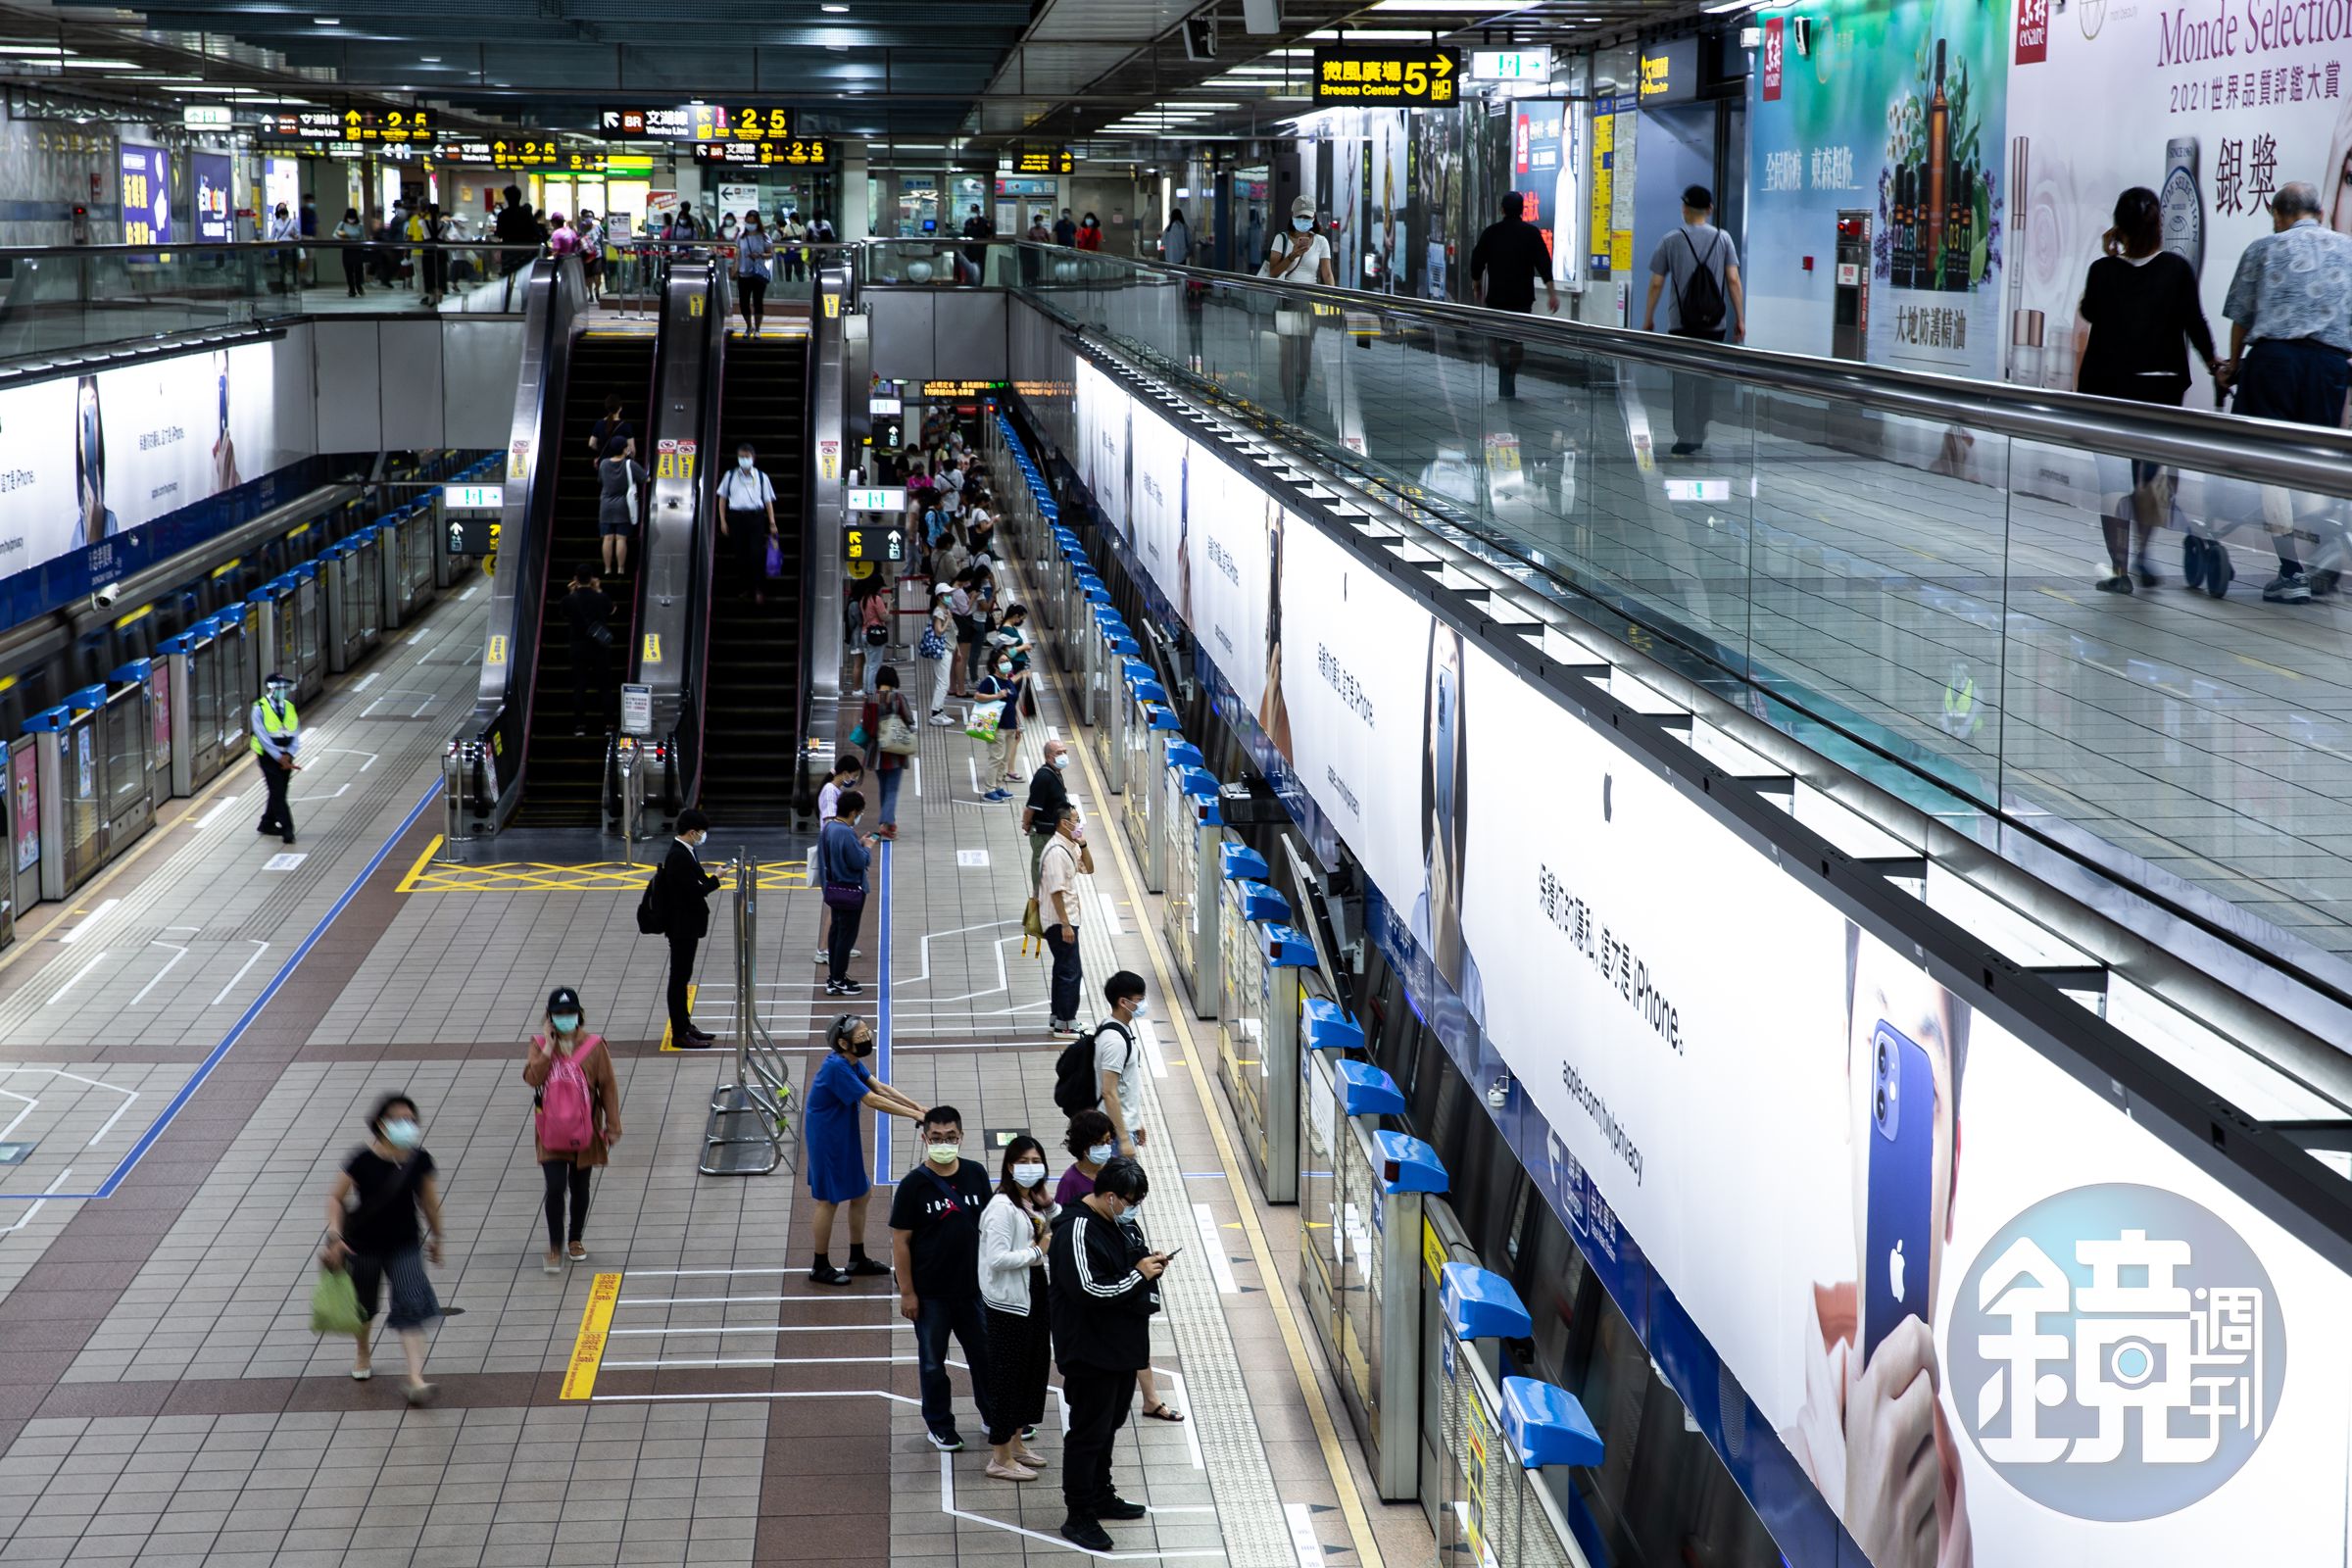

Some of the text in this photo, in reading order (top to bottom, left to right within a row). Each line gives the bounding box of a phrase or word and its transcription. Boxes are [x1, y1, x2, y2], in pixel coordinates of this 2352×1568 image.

[2157, 0, 2237, 67] Monde
[1323, 61, 1401, 81] 微風廣場
[1403, 62, 1427, 95] 5
[1320, 84, 1401, 95] Breeze Center
[625, 116, 642, 127] BR
[741, 108, 758, 129] 2
[770, 110, 786, 129] 5
[792, 141, 804, 156] 2
[811, 141, 823, 156] 5
[1563, 1059, 1643, 1188] apple.com/tw/privacy
